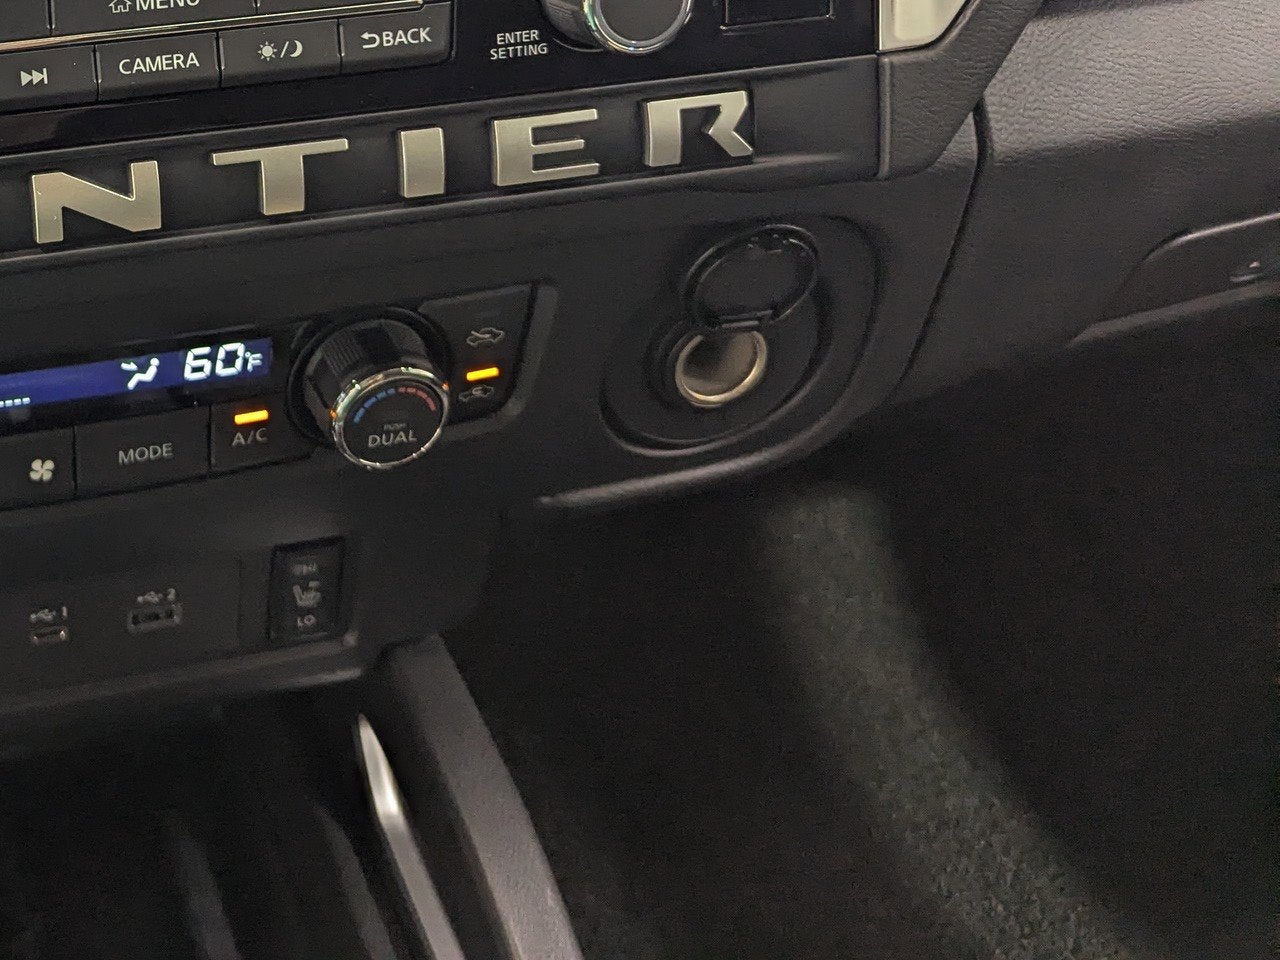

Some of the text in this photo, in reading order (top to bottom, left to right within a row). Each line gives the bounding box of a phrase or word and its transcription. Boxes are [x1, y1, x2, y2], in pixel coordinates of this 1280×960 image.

[382, 27, 432, 47] BACK
[496, 29, 539, 45] ENTER
[490, 42, 548, 60] SETTING
[118, 52, 200, 75] CAMERA
[232, 427, 268, 448] A/C
[367, 429, 418, 450] DUAL
[118, 442, 174, 465] MODE
